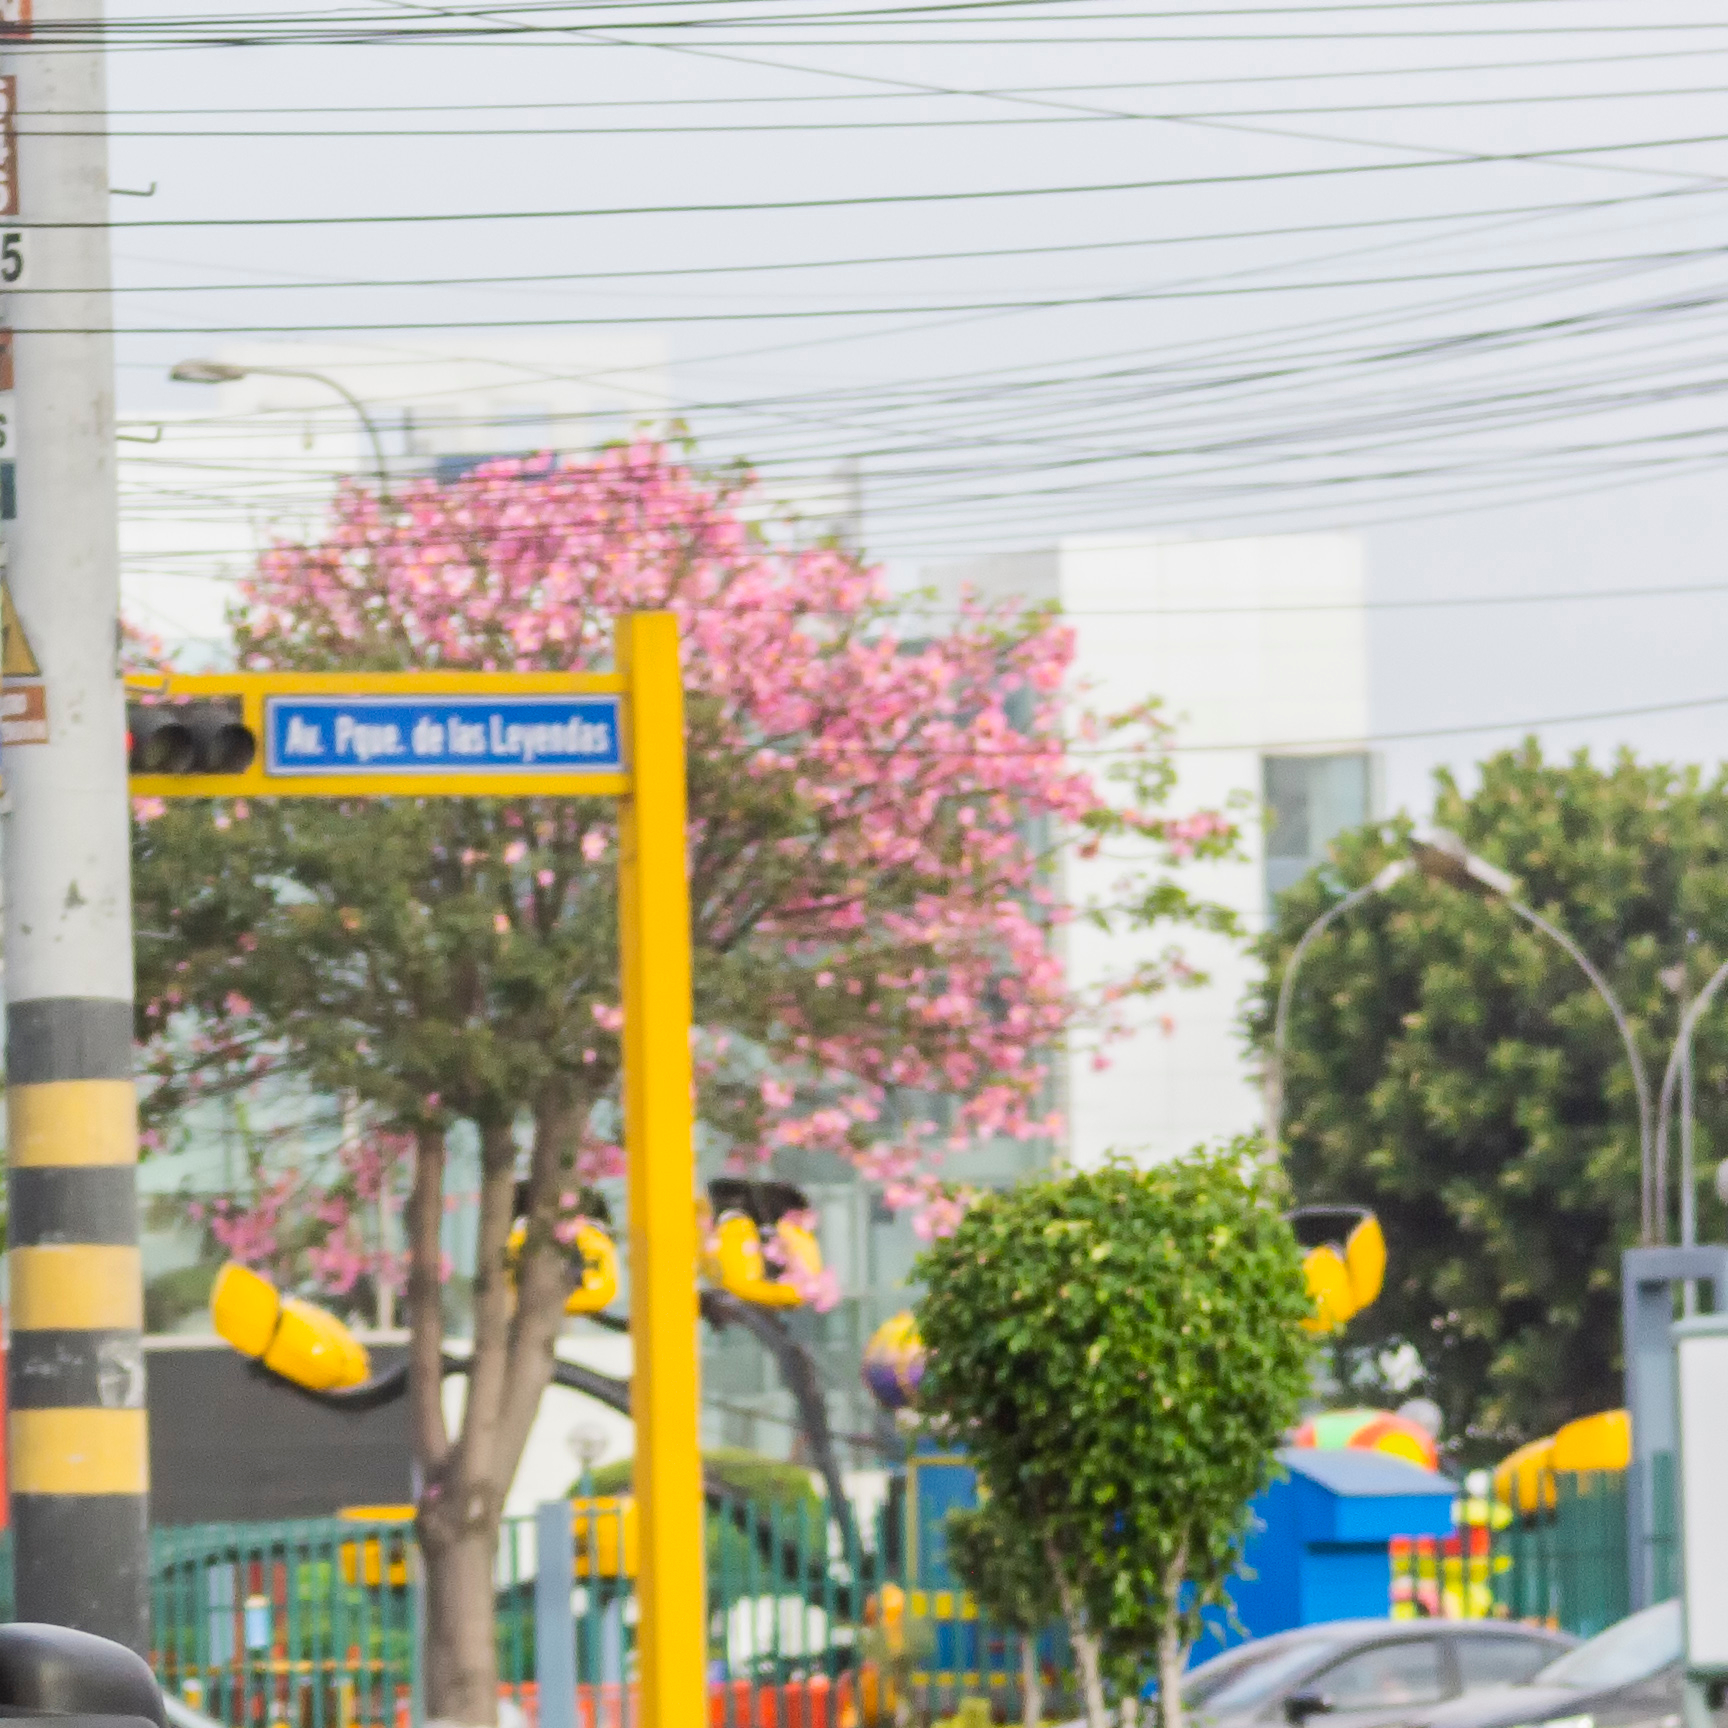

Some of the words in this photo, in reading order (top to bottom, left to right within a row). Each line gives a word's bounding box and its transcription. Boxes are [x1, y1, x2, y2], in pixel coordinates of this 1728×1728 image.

[285, 716, 324, 755] Av.
[411, 716, 443, 756] de
[448, 716, 486, 756] las
[489, 714, 610, 763] Leyendas
